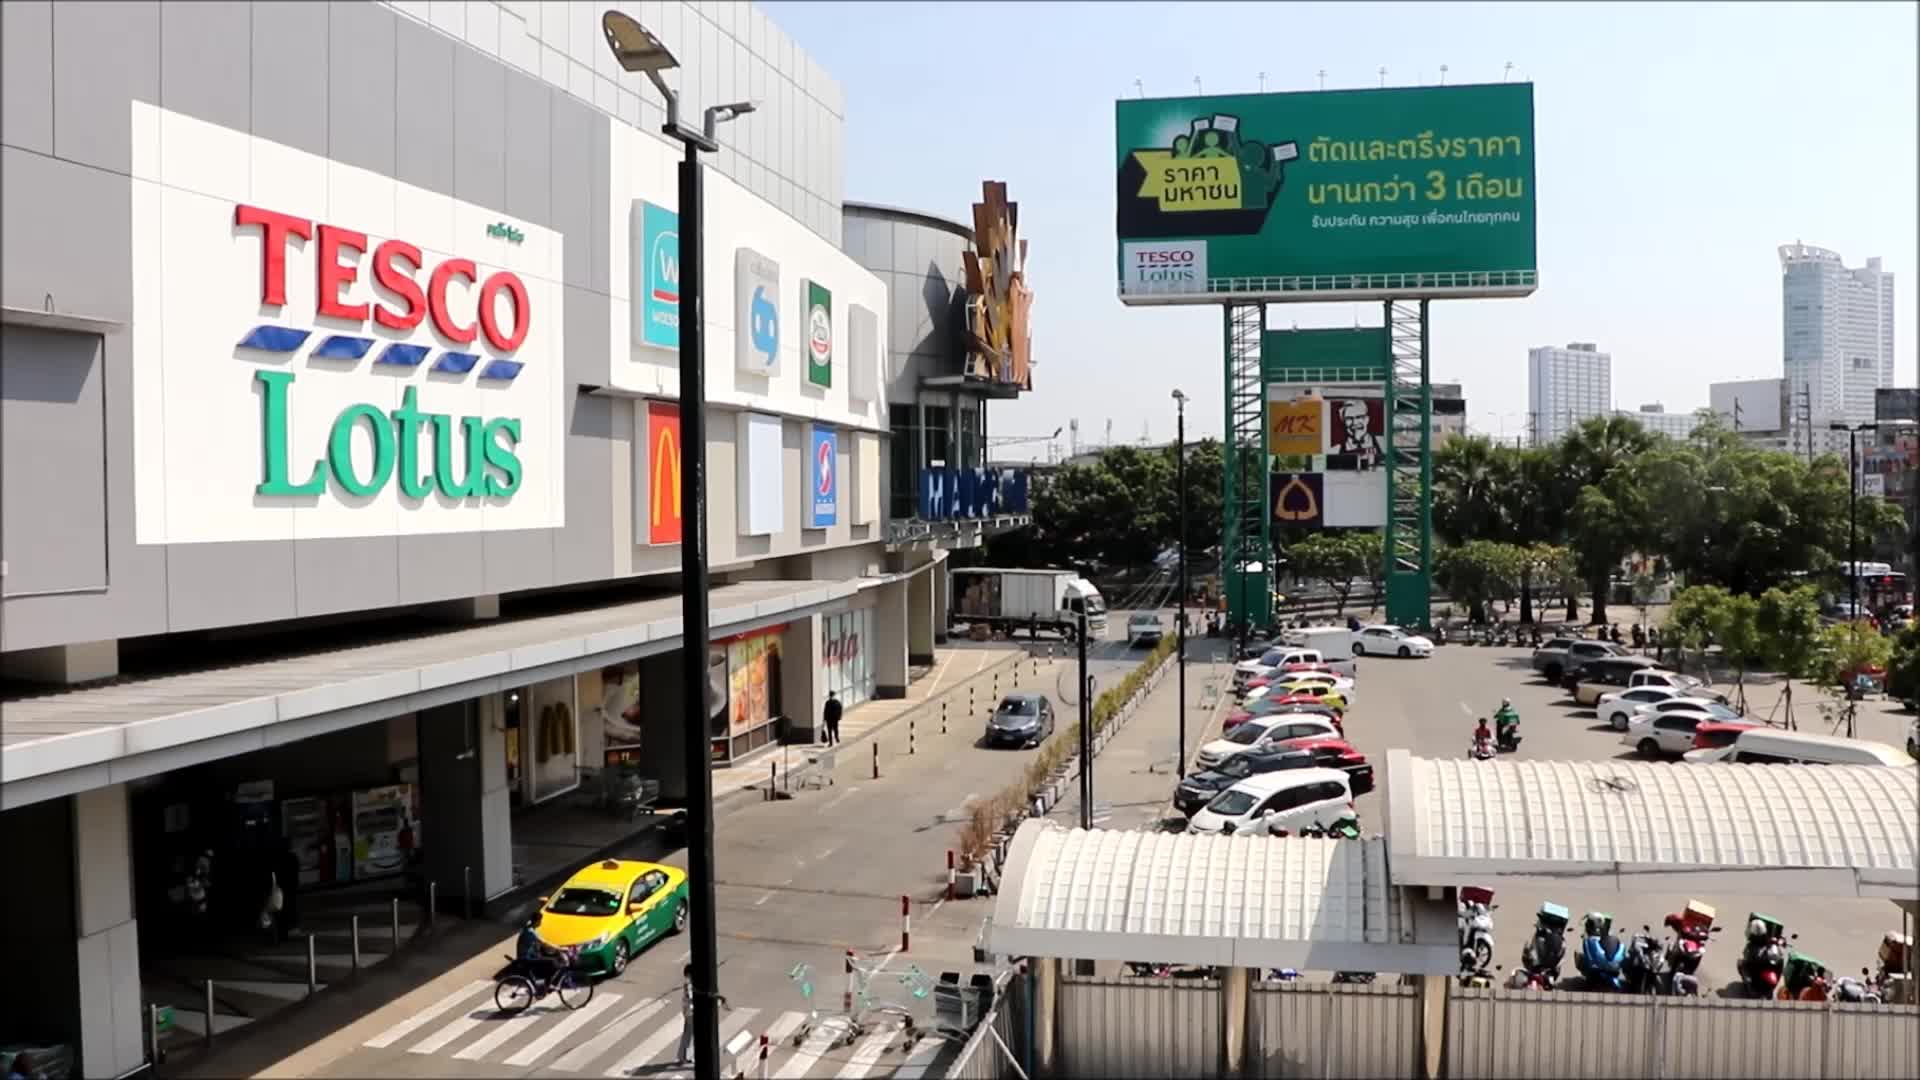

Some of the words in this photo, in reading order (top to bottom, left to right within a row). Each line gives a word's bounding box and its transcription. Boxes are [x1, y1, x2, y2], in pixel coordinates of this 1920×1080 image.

[1309, 131, 1521, 162] ตัดและตรึงราคา
[1164, 166, 1219, 183] ราคา
[1164, 184, 1238, 202] มหาชน
[1308, 174, 1416, 204] นานกว่า
[1424, 170, 1446, 200] 3
[1456, 172, 1523, 200] เดือน
[1136, 250, 1194, 263] TESCO
[234, 203, 531, 353] TESCO
[1139, 269, 1195, 282] Lotus
[255, 369, 524, 499] Lotus
